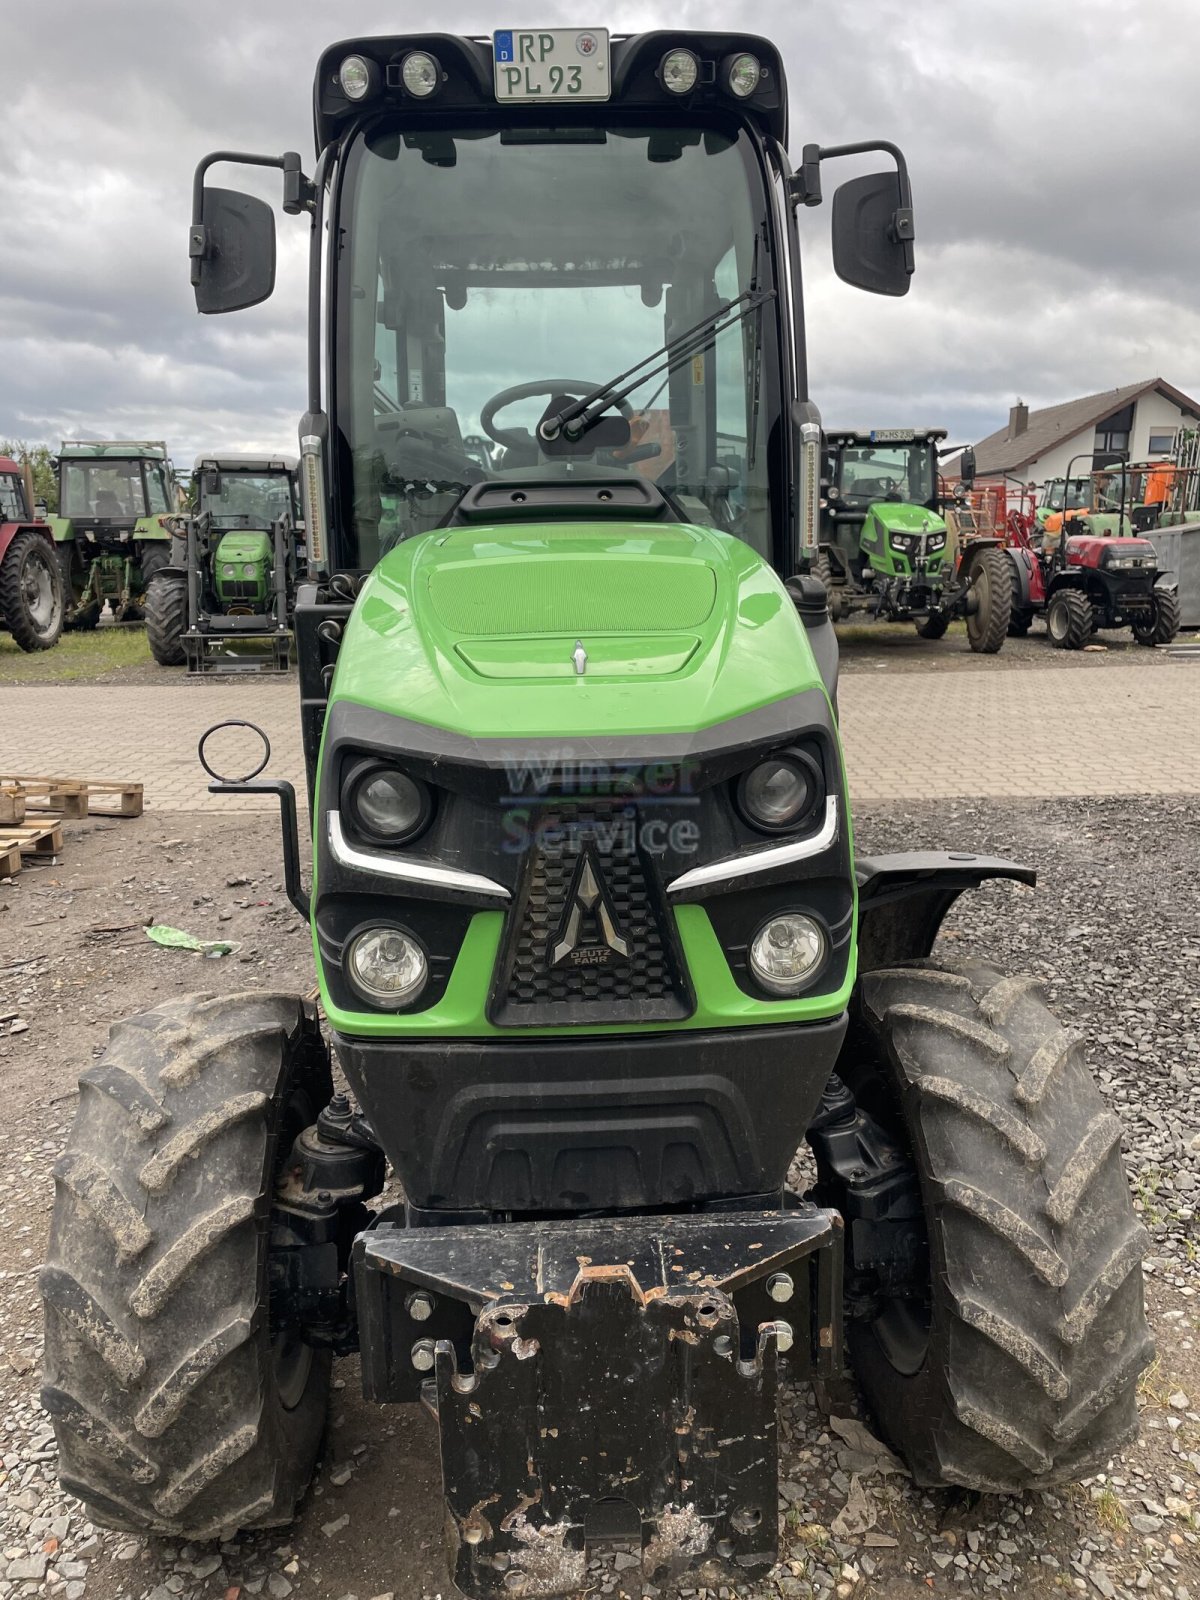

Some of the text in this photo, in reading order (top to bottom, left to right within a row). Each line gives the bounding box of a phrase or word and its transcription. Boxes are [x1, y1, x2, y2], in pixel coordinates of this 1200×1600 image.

[518, 33, 555, 63] RP
[501, 51, 508, 60] D
[505, 65, 582, 95] PL 93
[570, 948, 612, 959] DEUTZ
[574, 956, 608, 965] FAHR
